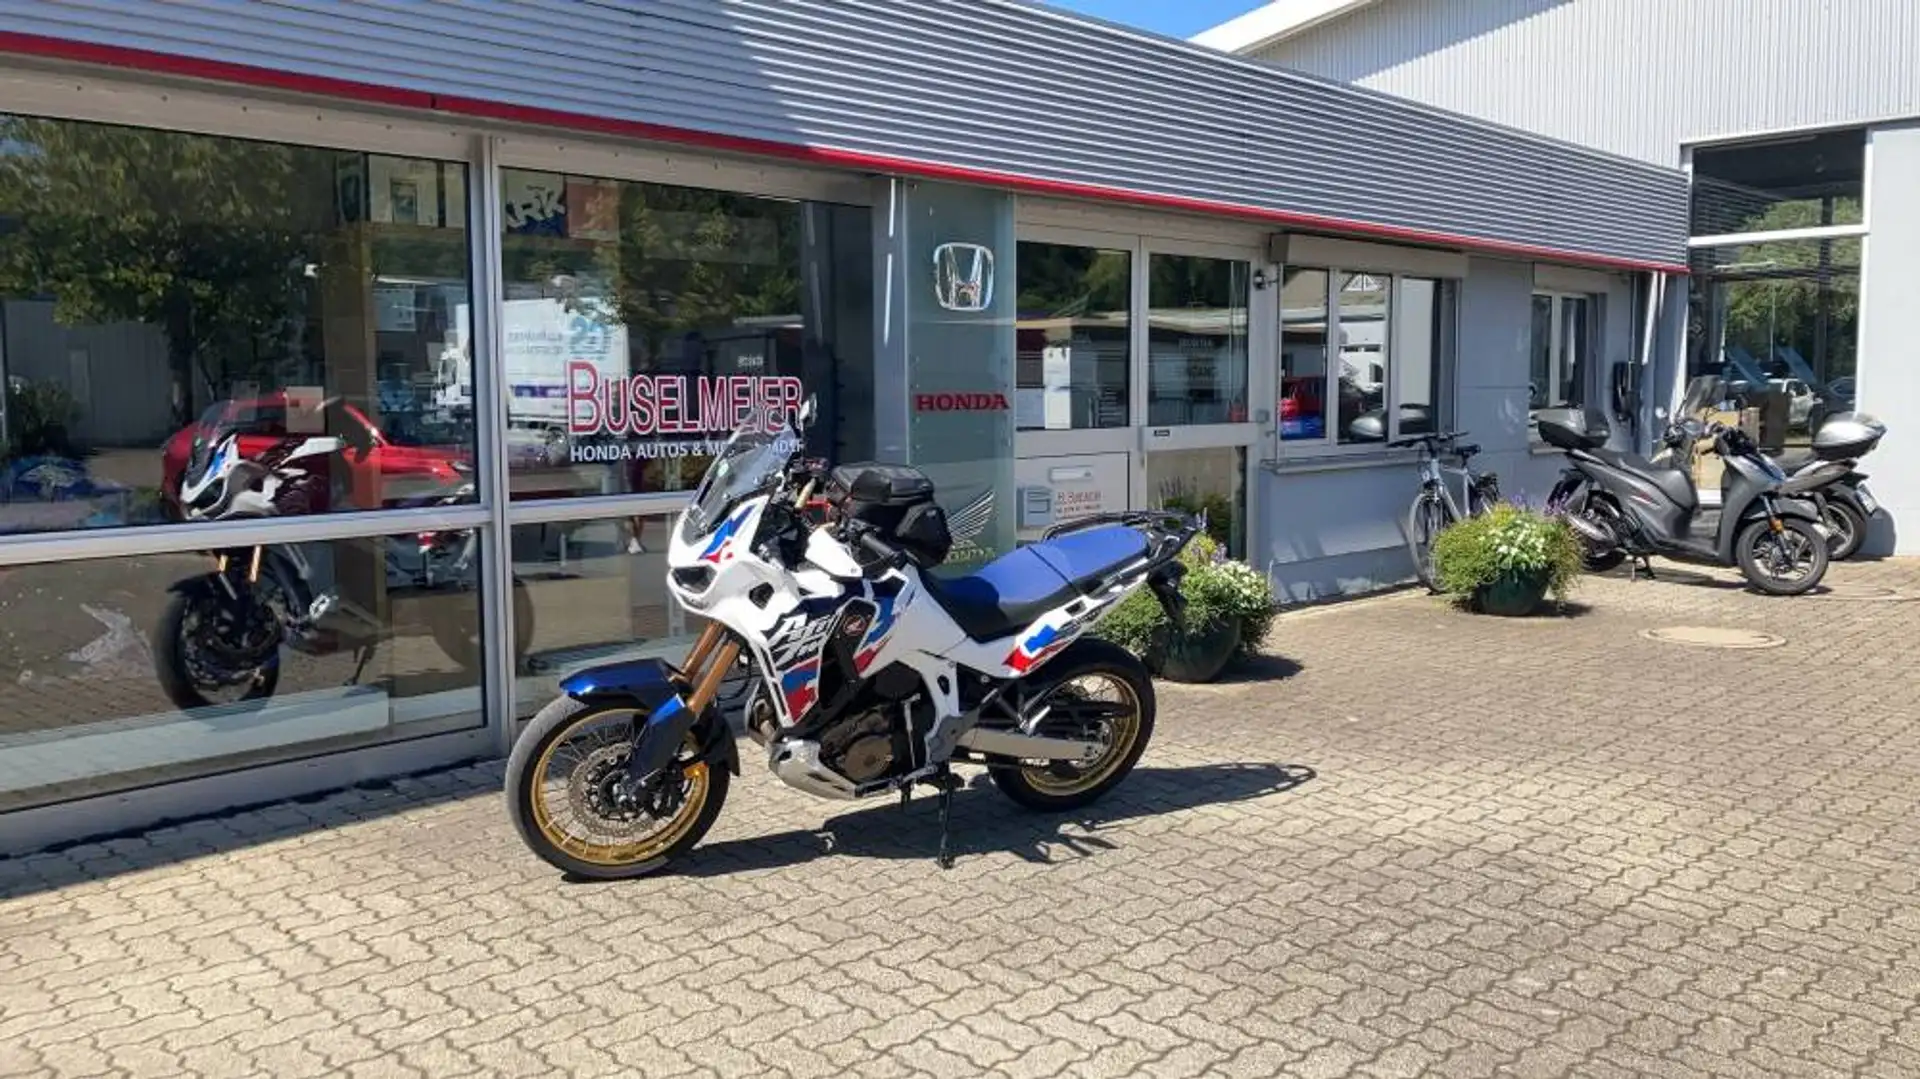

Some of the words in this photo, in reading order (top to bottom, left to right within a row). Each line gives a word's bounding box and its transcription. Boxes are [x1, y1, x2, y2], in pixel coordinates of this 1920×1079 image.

[566, 359, 803, 436] BUSELMEIER
[915, 392, 1010, 412] HONDA
[570, 444, 632, 462] HONDA
[635, 442, 687, 460] AUTOS
[690, 443, 702, 457] &
